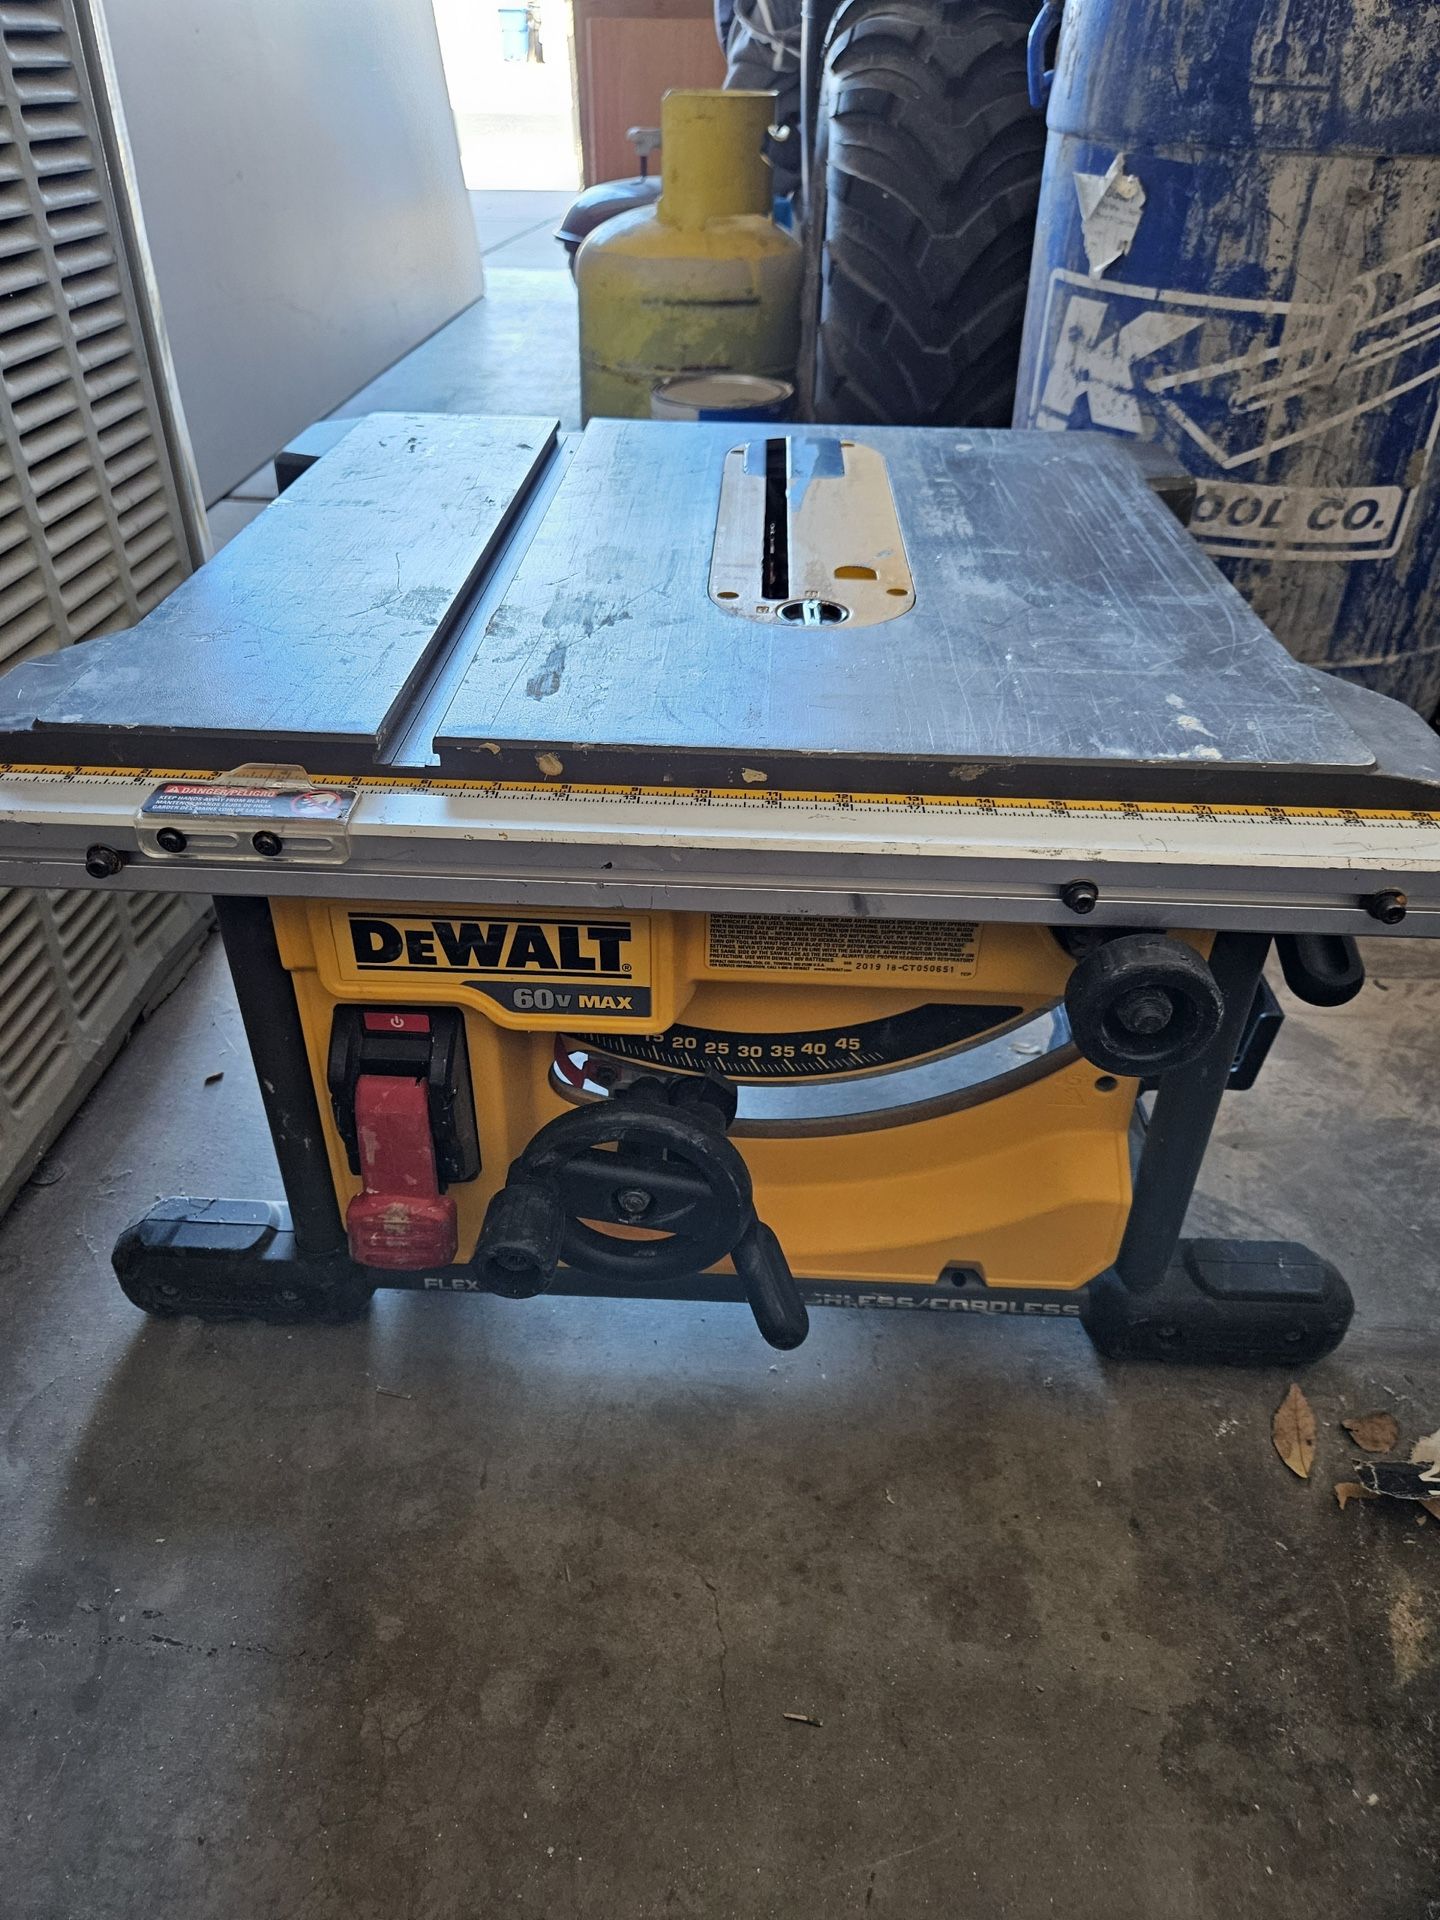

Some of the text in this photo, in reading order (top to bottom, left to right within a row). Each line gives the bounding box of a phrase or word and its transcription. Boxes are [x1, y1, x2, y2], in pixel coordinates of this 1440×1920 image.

[1036, 296, 1204, 435] K
[1306, 496, 1385, 531] CO.
[181, 785, 278, 798] DANGER/PELIGRO
[856, 962, 881, 970] 2019
[578, 994, 633, 1010] MAX
[672, 1036, 697, 1049] 20
[705, 1042, 730, 1055] 25
[737, 1045, 763, 1058] 30
[770, 1044, 796, 1058] 35
[801, 1043, 827, 1056] 40
[835, 1037, 860, 1050] 45
[424, 1278, 480, 1291] FLEX
